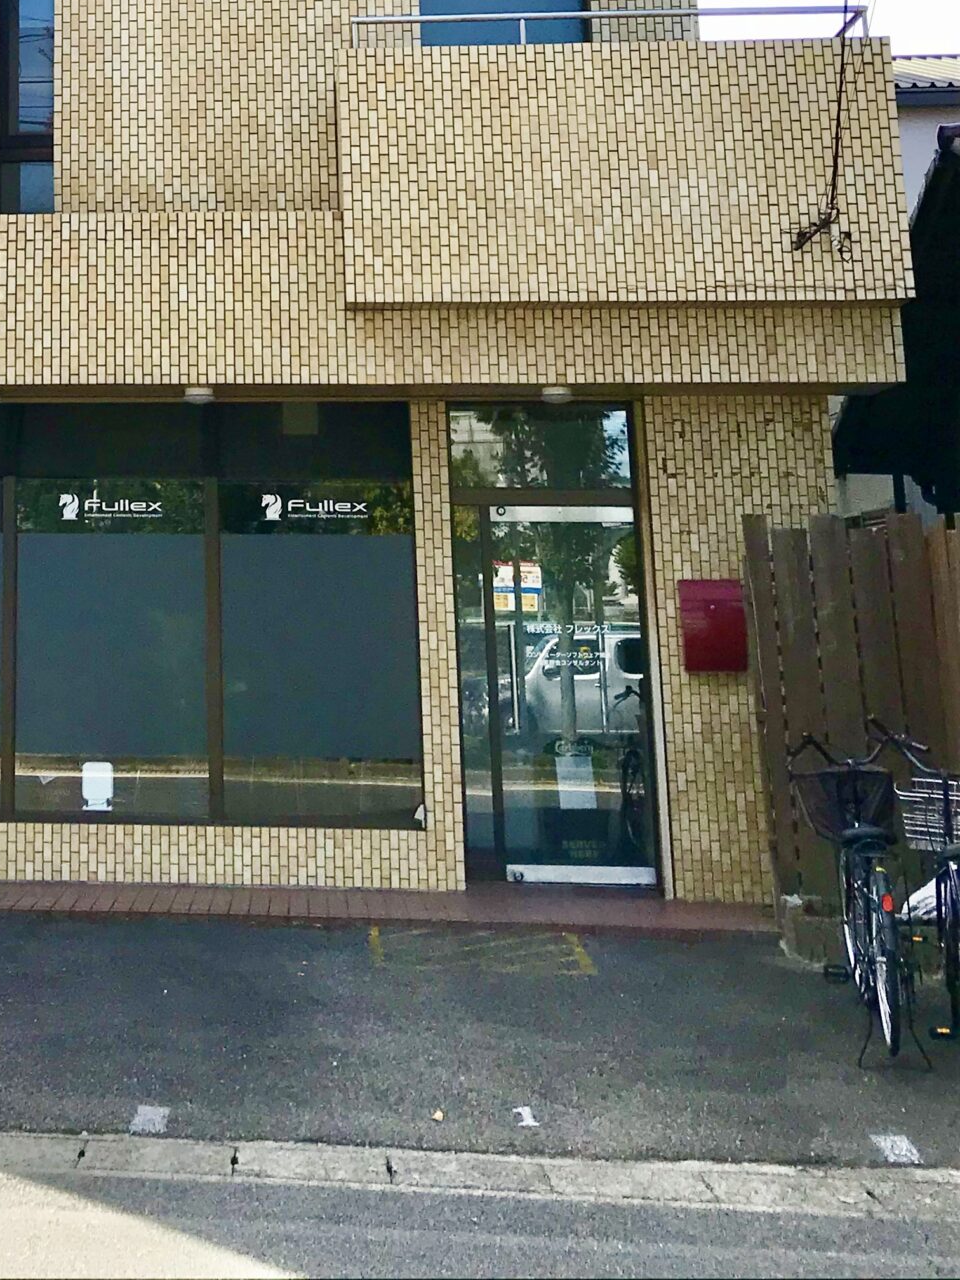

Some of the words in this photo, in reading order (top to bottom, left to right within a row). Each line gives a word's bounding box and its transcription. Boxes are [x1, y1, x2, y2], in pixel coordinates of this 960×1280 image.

[84, 499, 162, 512] Fullex
[287, 499, 368, 512] Fullex
[526, 624, 563, 635] 株式会社
[565, 624, 610, 634] フレックス
